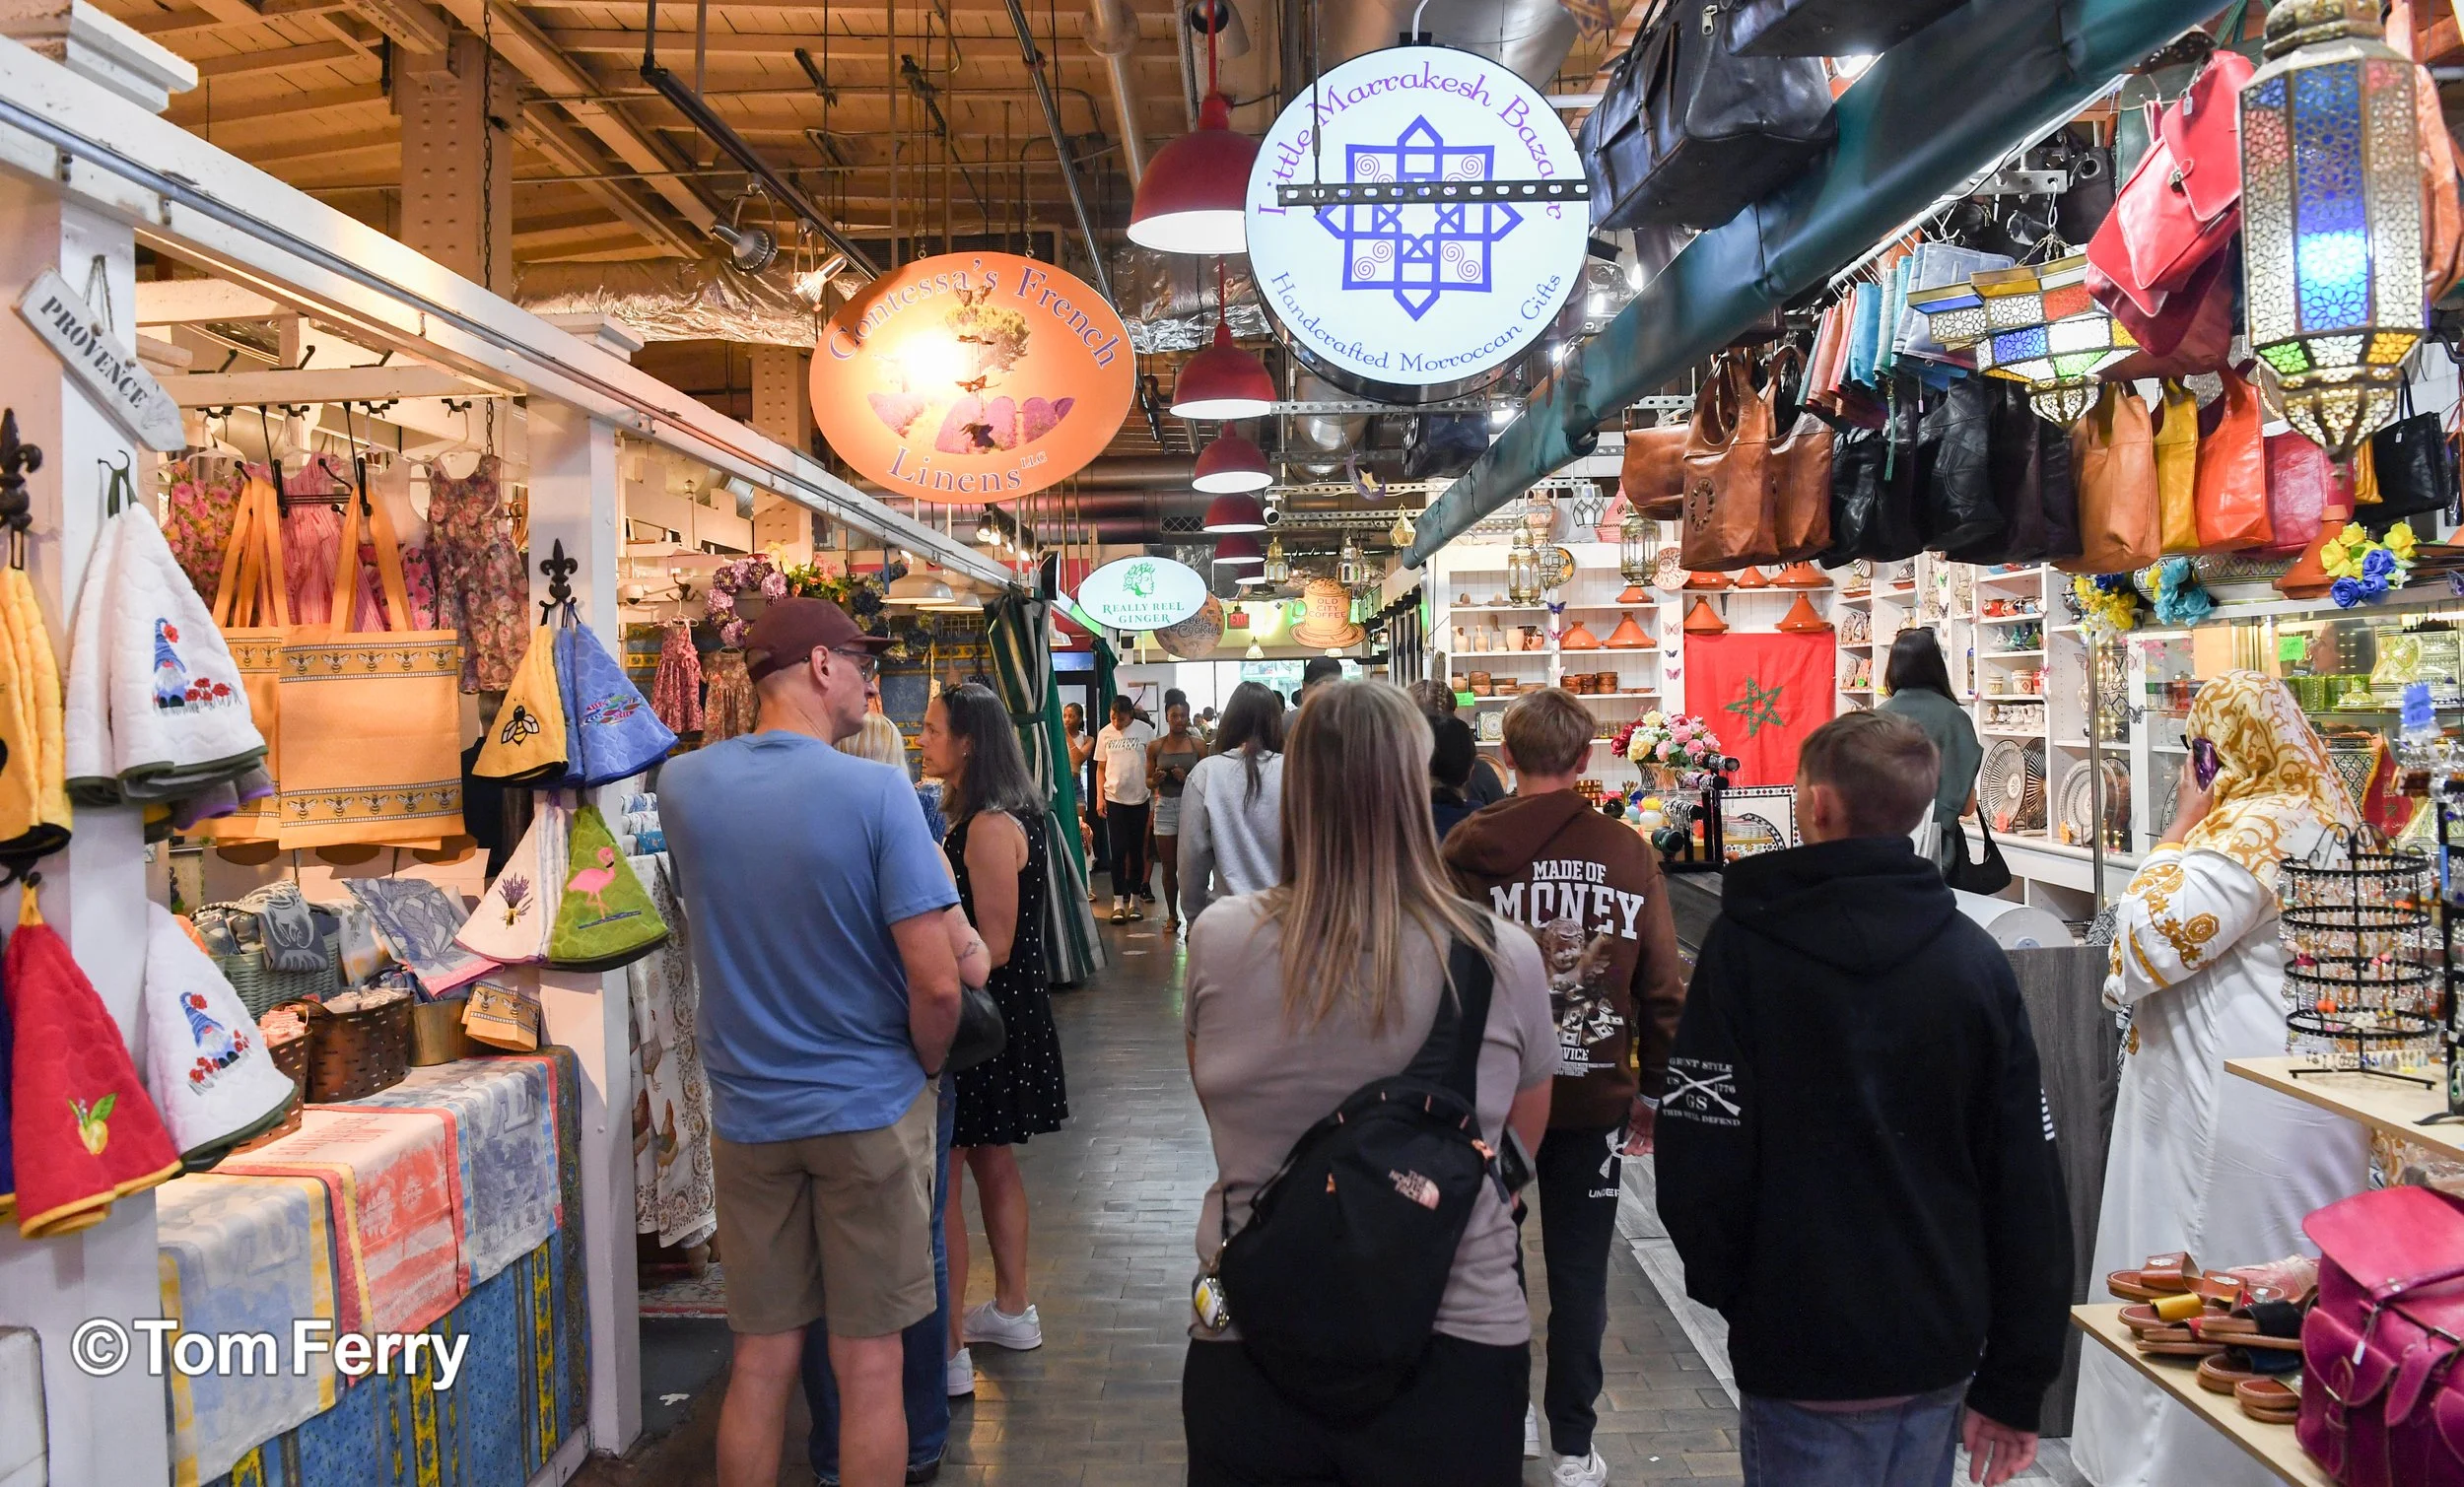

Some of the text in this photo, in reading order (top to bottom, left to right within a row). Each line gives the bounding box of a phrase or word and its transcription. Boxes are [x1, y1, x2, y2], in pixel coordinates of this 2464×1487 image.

[1259, 61, 1561, 220] Lttle Marrakesh Bazar
[829, 259, 1120, 370] Contessa's French
[1270, 271, 1561, 372] Handcrafted Morroccan Gifts
[40, 296, 148, 408] PROVENCE
[889, 445, 1048, 493] Linens LLC
[1103, 601, 1185, 615] REALLY REEL
[1119, 614, 1171, 624] GINGER
[1533, 860, 1607, 884] MADE OF
[1490, 882, 1644, 940] MONEY
[1561, 1046, 1590, 1061] VICE
[1701, 1061, 1733, 1073] STYLE
[1685, 1094, 1707, 1111] GS
[1701, 1115, 1741, 1125] DEFEND
